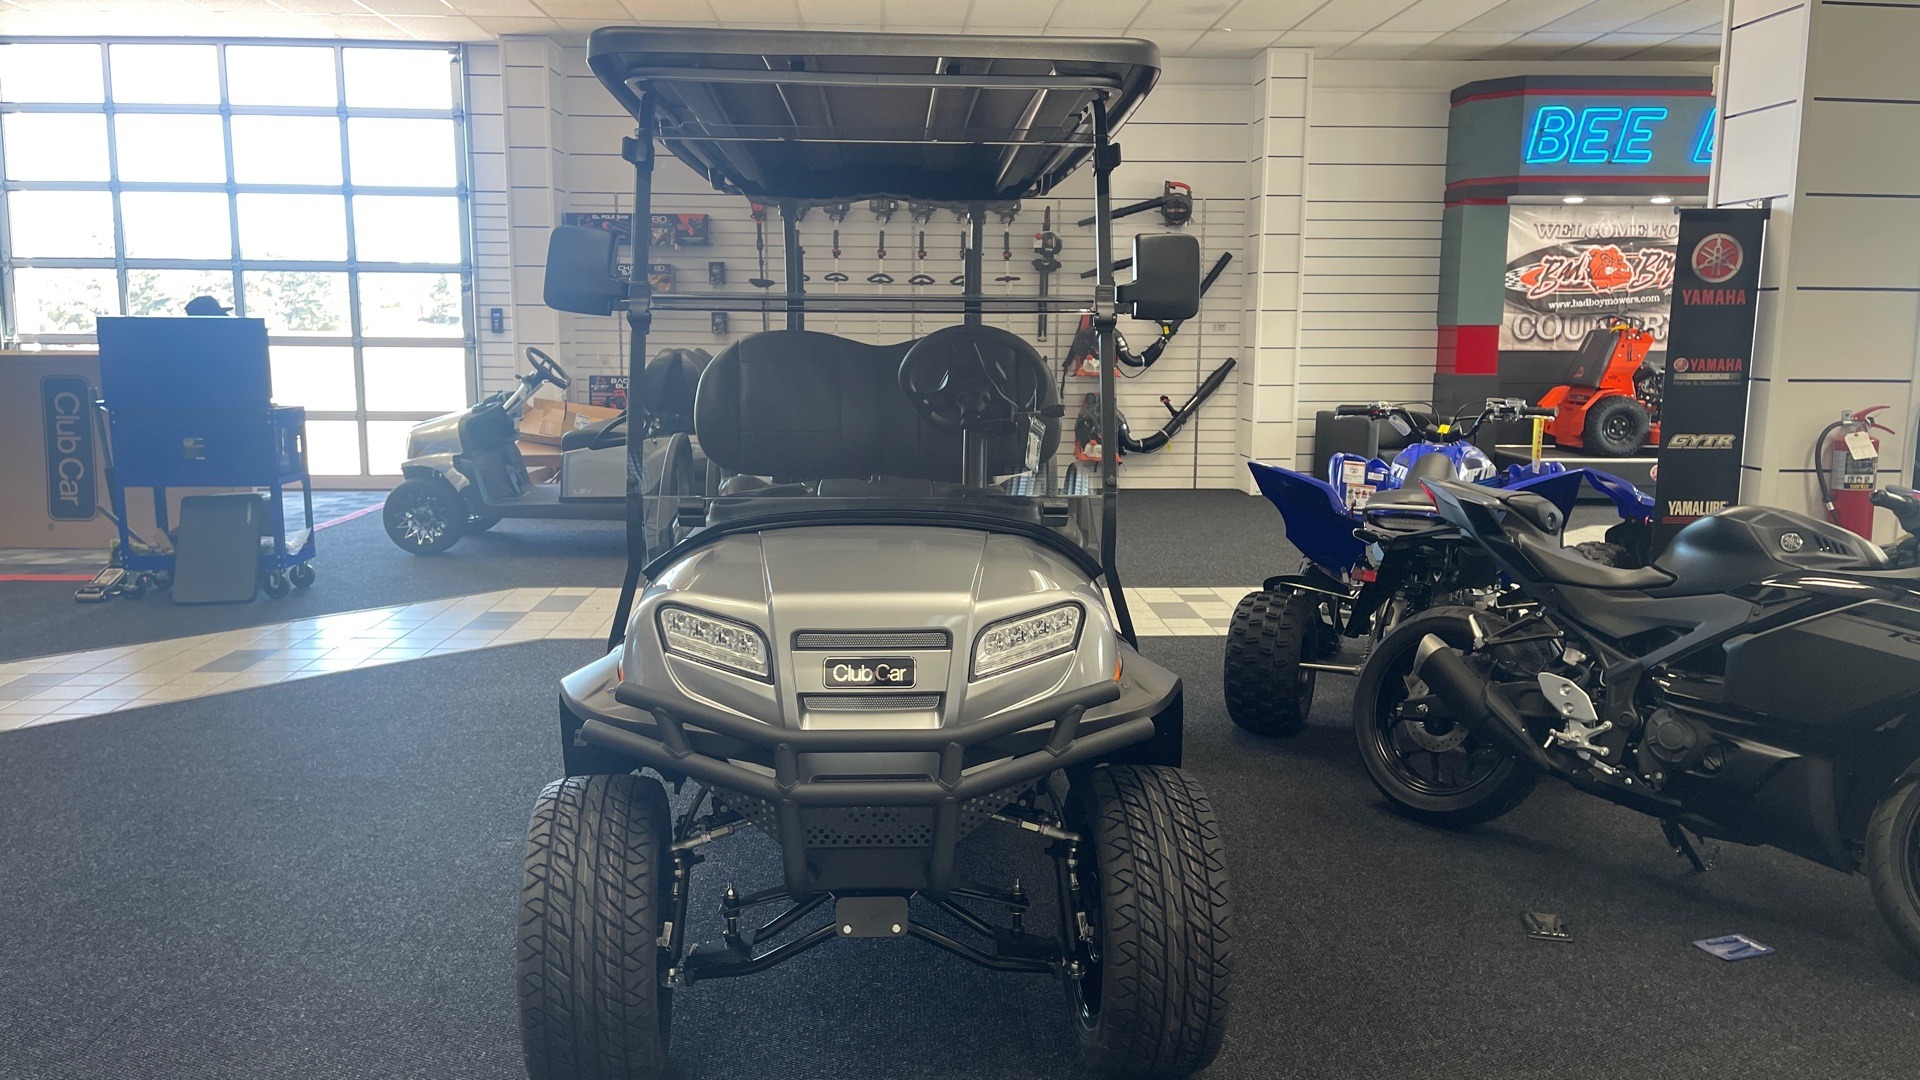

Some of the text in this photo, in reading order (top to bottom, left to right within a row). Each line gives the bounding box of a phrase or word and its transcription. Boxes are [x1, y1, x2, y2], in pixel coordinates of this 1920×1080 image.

[1526, 106, 1668, 163] BEE
[1534, 222, 1679, 239] WELCOME TO
[1526, 253, 1590, 300] Bad
[1548, 294, 1661, 310] www.badboymowers.com
[1682, 289, 1747, 305] YAMAHA
[1690, 358, 1743, 371] YAMAHA
[54, 391, 85, 506] Club Car
[1667, 433, 1736, 449] GYTR
[832, 664, 907, 682] Club Car
